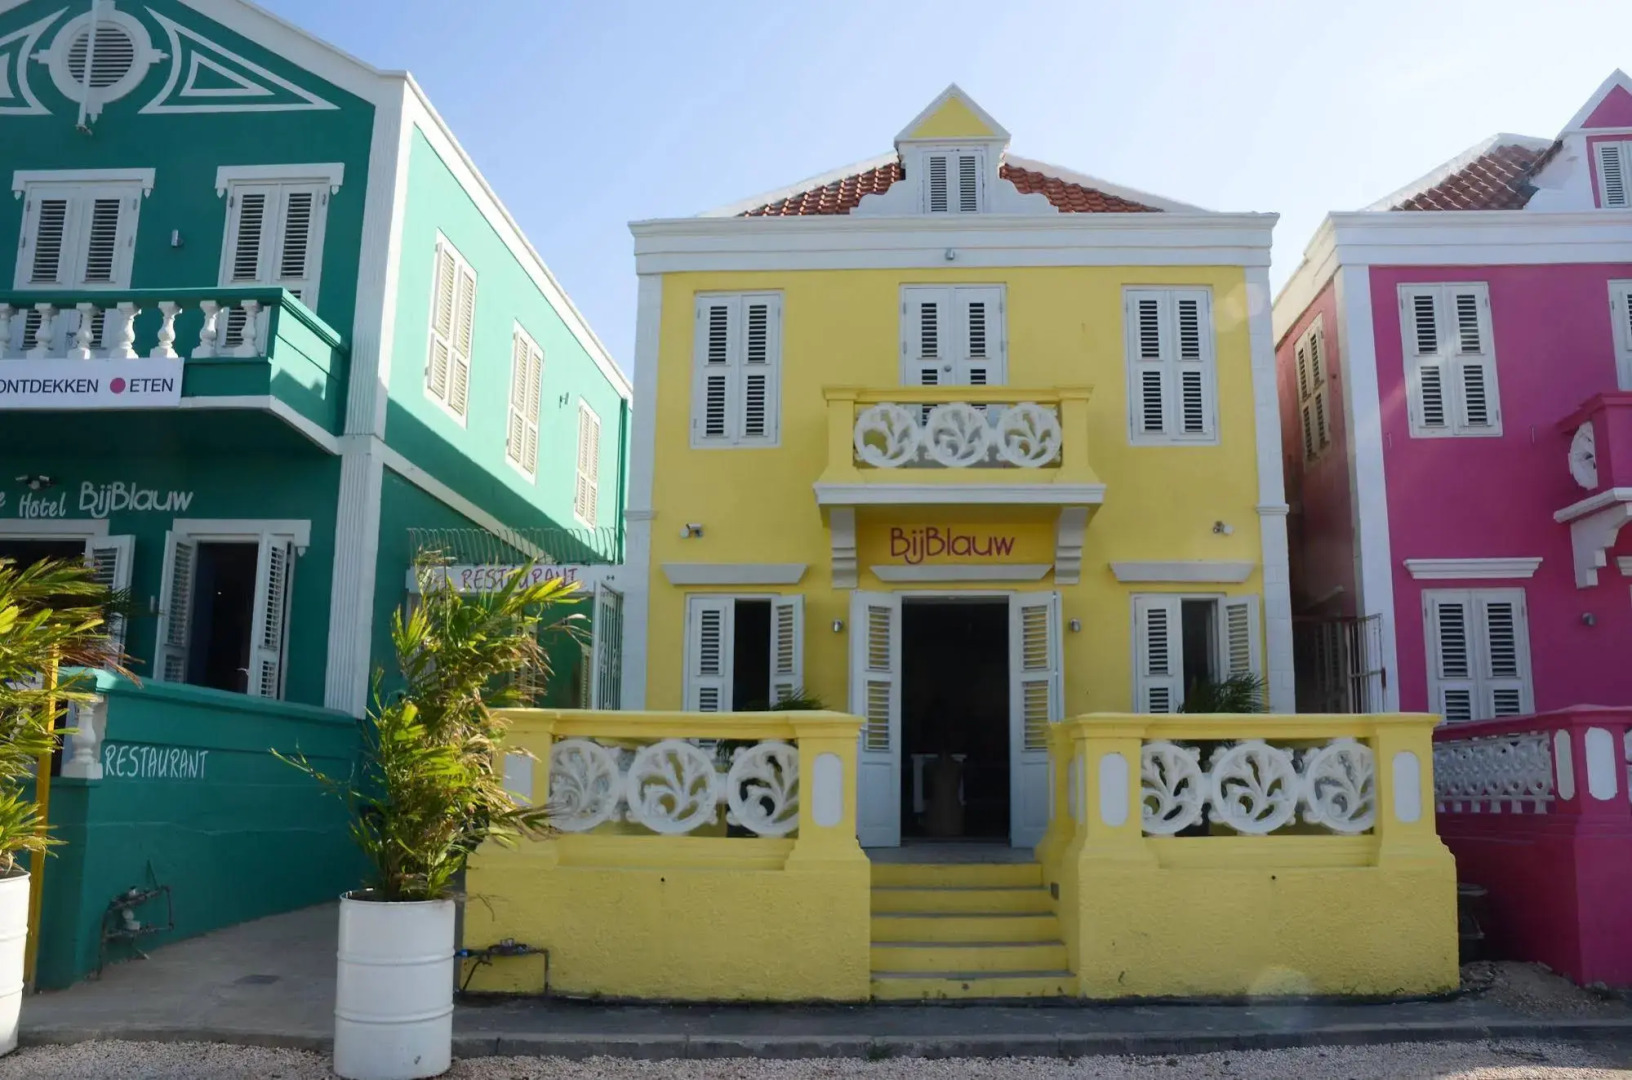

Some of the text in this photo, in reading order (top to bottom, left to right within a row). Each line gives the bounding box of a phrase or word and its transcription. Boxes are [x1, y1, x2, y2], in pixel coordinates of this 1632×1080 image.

[129, 378, 174, 393] ETEN
[19, 491, 66, 519] Hotel
[79, 481, 194, 519] BijBlauw
[890, 527, 1015, 565] BijBlauw
[105, 744, 208, 779] RESTAURANT
